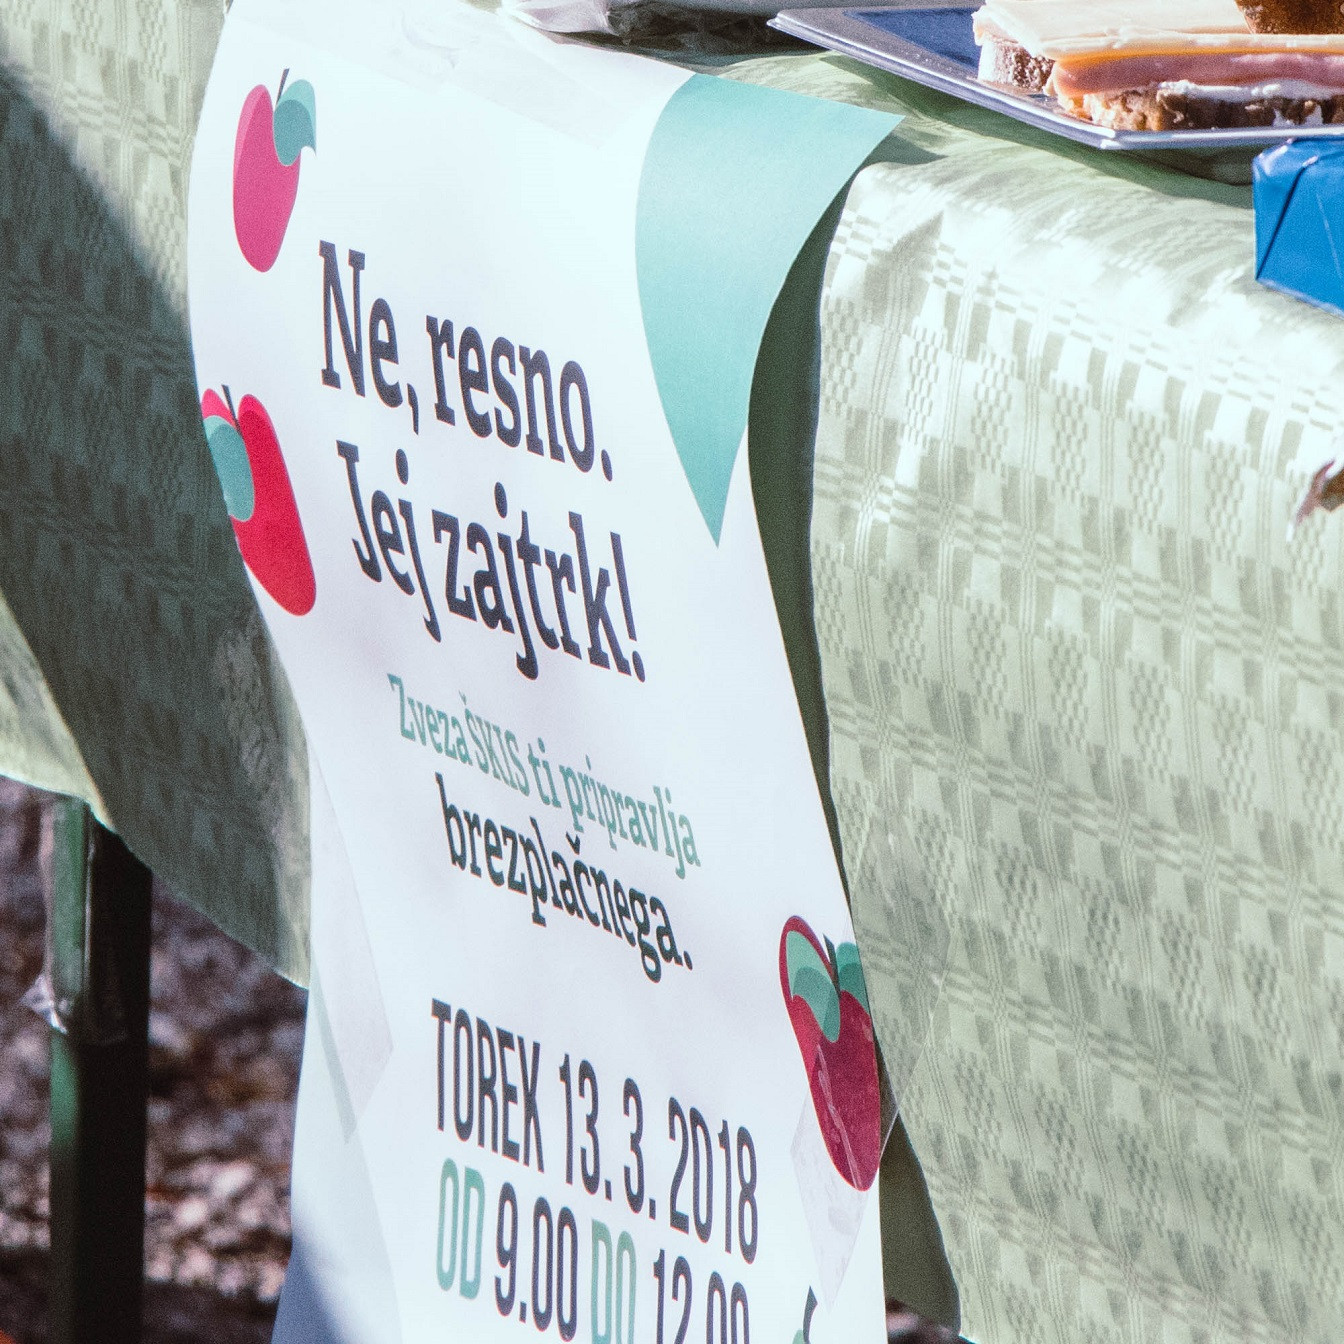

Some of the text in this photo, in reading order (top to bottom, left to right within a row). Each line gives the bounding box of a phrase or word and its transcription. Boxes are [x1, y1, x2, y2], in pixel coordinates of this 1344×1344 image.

[320, 240, 614, 482] Ne, resno.
[336, 439, 647, 684] Jej zajtrk!
[387, 673, 702, 880] Zveza ŠKIS ti pripravlja
[435, 771, 693, 984] brezplačnega.
[432, 998, 758, 1265] TOREK 13. 3. 2018
[436, 1158, 486, 1300] OD
[494, 1182, 579, 1343] 9.00
[590, 1218, 638, 1344] DO
